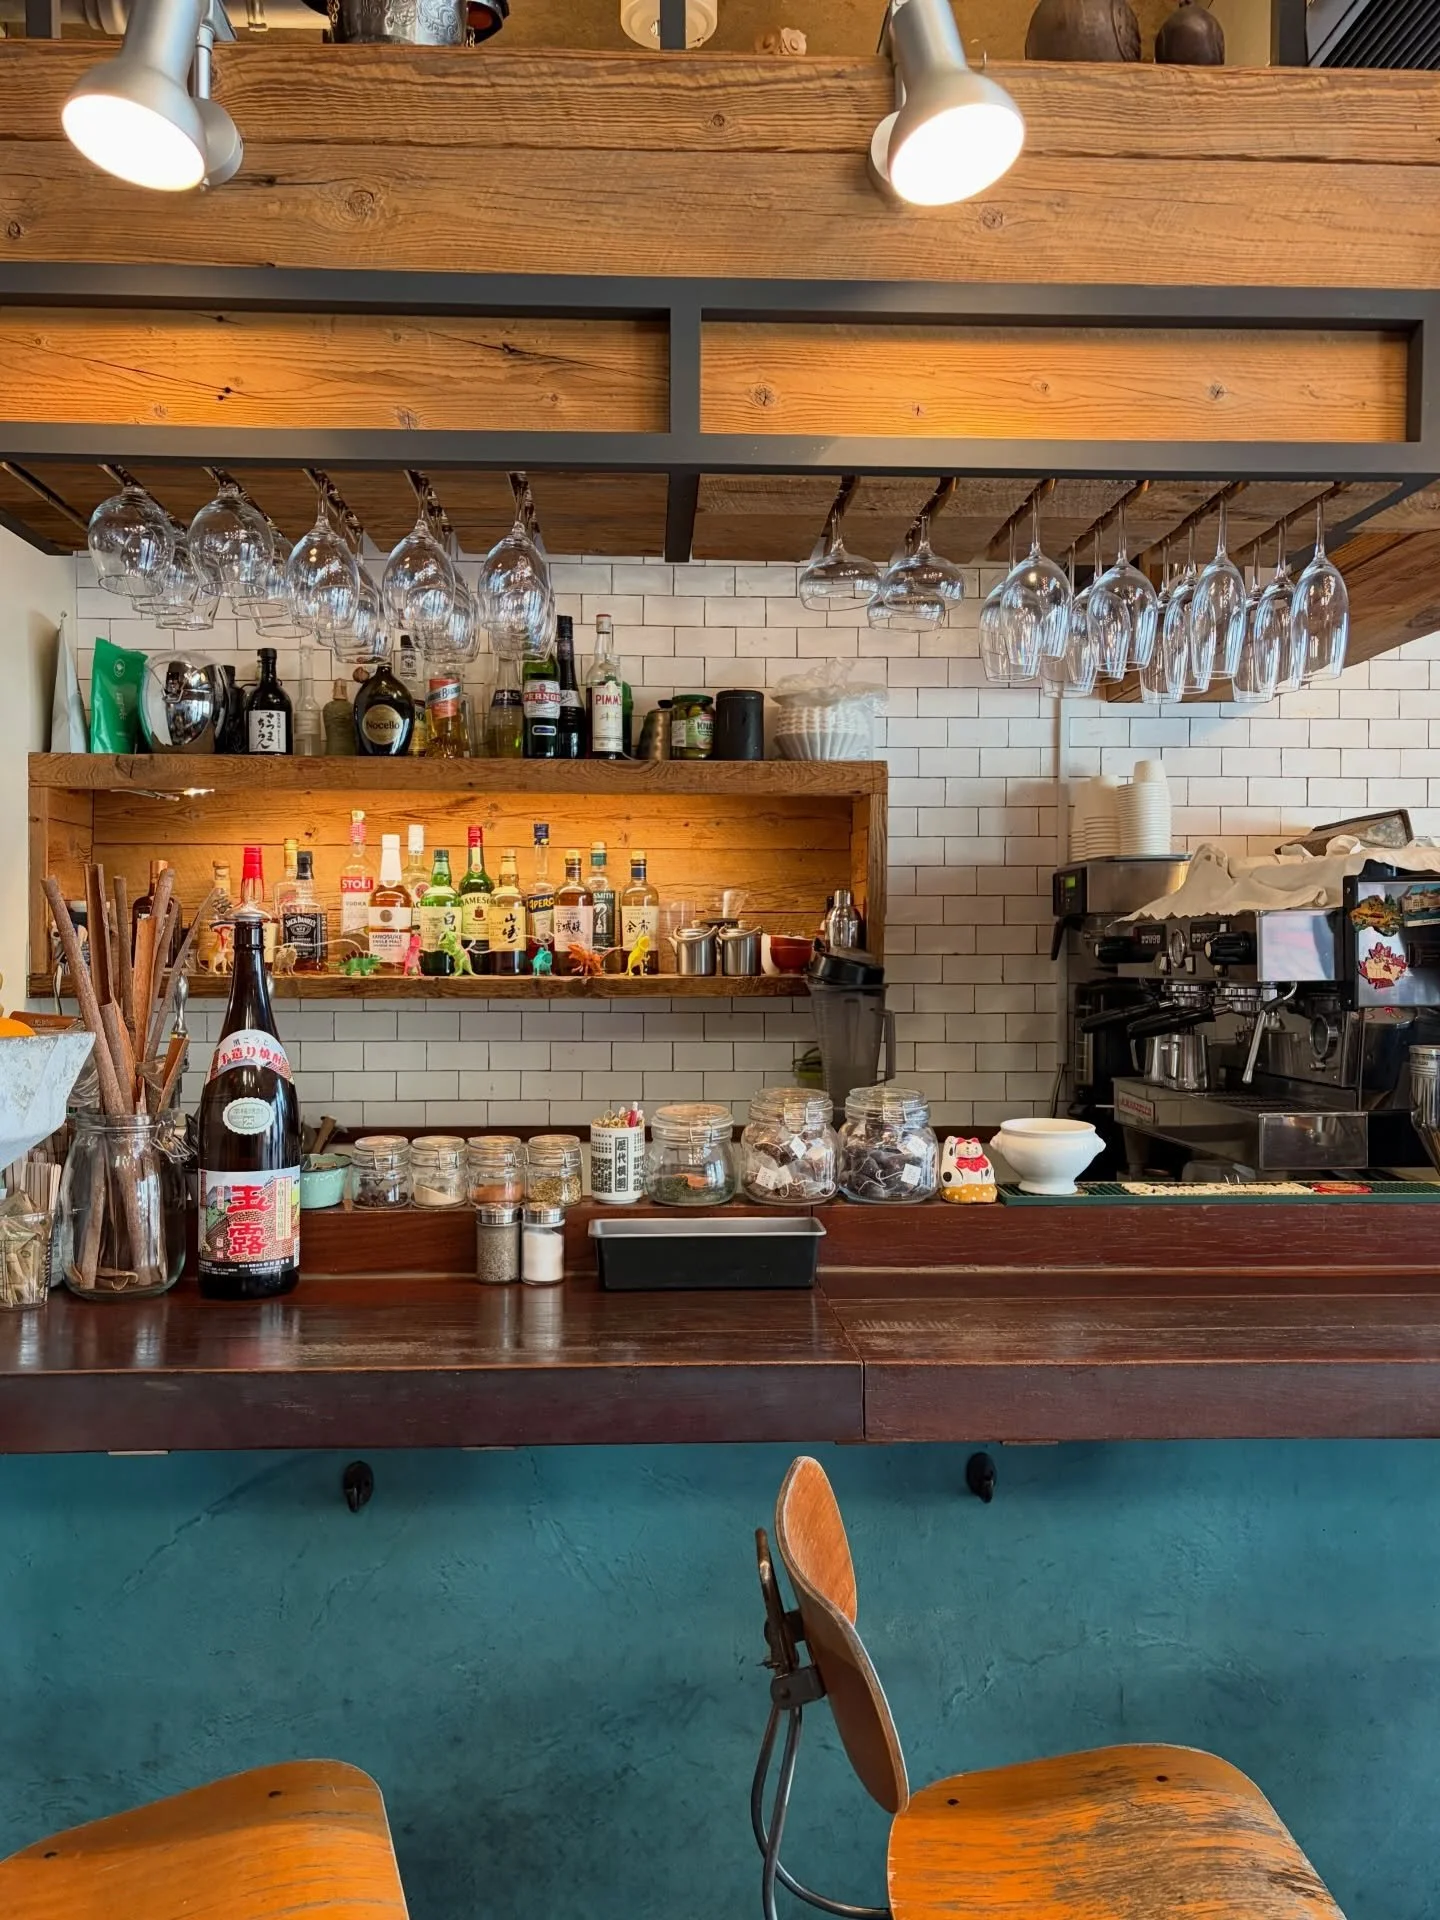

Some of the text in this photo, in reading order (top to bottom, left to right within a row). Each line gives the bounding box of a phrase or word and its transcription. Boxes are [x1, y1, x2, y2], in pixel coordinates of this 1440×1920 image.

[495, 691, 520, 700] BOLS
[366, 721, 400, 729] Nocello
[342, 879, 371, 889] STOLI
[285, 917, 298, 928] JACK
[242, 1116, 254, 1129] 25
[226, 1185, 273, 1257] 玉露
